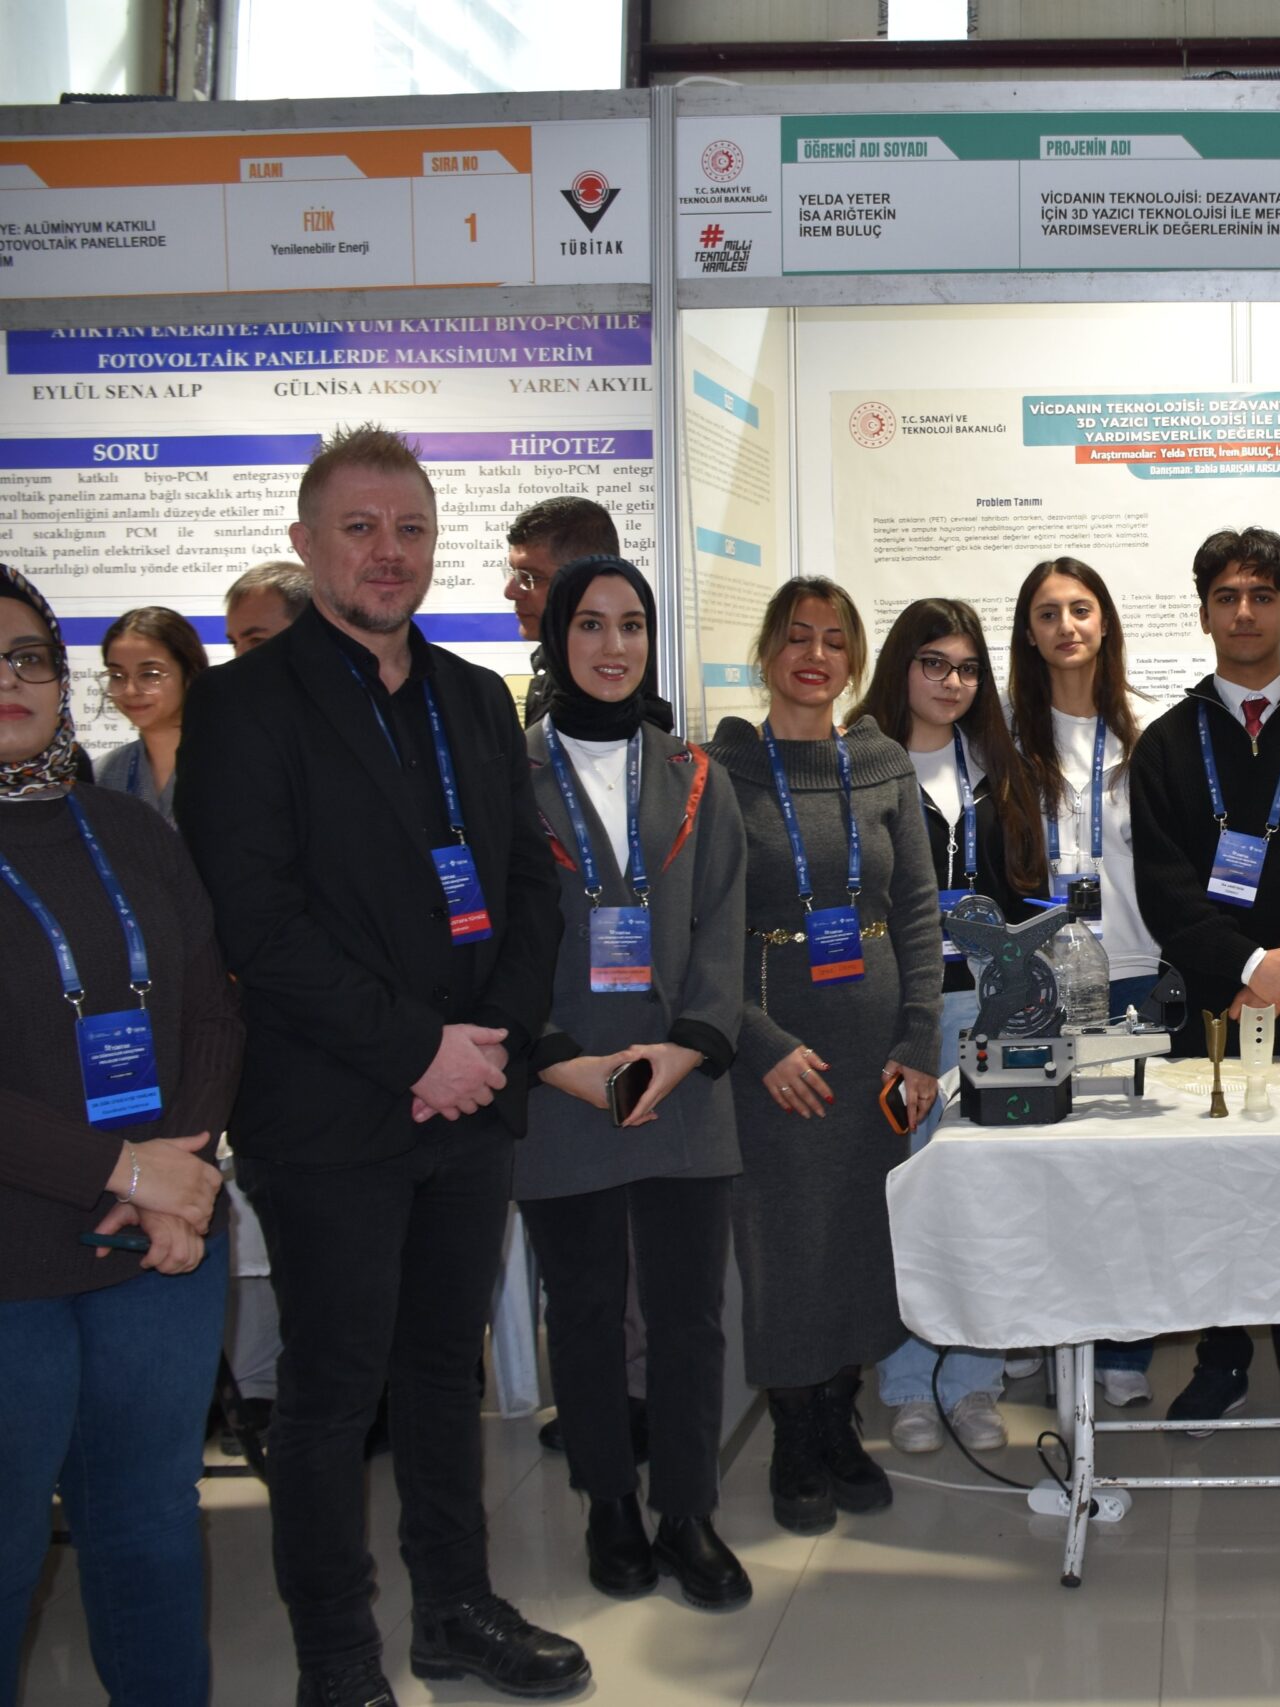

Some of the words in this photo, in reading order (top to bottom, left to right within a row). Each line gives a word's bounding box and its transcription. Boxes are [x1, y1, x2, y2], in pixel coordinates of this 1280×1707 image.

[804, 137, 855, 158] ÖĞRENCİ
[859, 136, 880, 157] ADI
[883, 136, 927, 157] SOYADI
[1046, 138, 1106, 155] PROJENİN
[1110, 140, 1131, 155] ADI
[249, 163, 282, 178] ALANI
[431, 157, 458, 172] SIRA
[462, 156, 478, 170] NO
[799, 194, 843, 205] YELDA
[846, 193, 890, 204] YETER
[1041, 190, 1105, 204] VİCDANIN
[1109, 189, 1201, 204] TEKNOLOJİSİ:
[303, 207, 334, 231] FİZİK
[799, 208, 821, 221] İSA
[823, 207, 896, 220] ARIĞTEKİN
[1041, 206, 1067, 222] İÇİN
[1071, 209, 1088, 220] 3D
[1092, 208, 1134, 219] YAZICI
[1138, 205, 1226, 220] TEKNOLOJİSİ
[1230, 206, 1250, 220] İLE
[24, 221, 102, 234] ALÜMİNYUM
[106, 221, 155, 232] KATKILI
[465, 214, 476, 242] 1
[799, 224, 831, 237] İREM
[836, 225, 881, 238] BULUÇ
[1041, 222, 1158, 235] YARDIMSEVERLİK
[1163, 222, 1262, 235] DEĞERLERİNİN
[271, 243, 336, 255] Yenilenebilir
[338, 242, 369, 255] Enerji
[560, 239, 622, 255] TÜBİTAK
[98, 350, 249, 368] FOTOVOLTAİK
[255, 349, 388, 366] PANELLERDE
[395, 346, 517, 363] MAKSİMUM
[523, 344, 592, 361] VERİM
[33, 382, 99, 400] EYLÜL
[105, 385, 157, 399] SENA
[164, 384, 202, 398] ALP
[273, 378, 361, 396] GÜLNİSA
[369, 380, 441, 394] AKSOY
[509, 379, 579, 393] YAREN
[1029, 402, 1101, 414] VİCDANIN
[1106, 399, 1204, 413] TEKNOLOJİSİ:
[901, 416, 917, 424] T.C.
[919, 415, 953, 423] SANAYİ
[1077, 418, 1096, 428] 3D
[1100, 417, 1148, 427] YAZICI
[1152, 413, 1246, 427] TEKNOLOJİSİ
[1251, 412, 1272, 425] İLE
[901, 426, 953, 434] TEKNOLOJİ
[955, 424, 1006, 433] BAKANLIĞI
[1085, 428, 1212, 442] YARDIMSEVERLİK
[510, 434, 615, 455] HİPOTEZ
[93, 444, 158, 461] SORU
[1090, 450, 1156, 460] Araştırmacılar:
[1160, 448, 1185, 458] Yelda
[1187, 447, 1216, 457] YETER,
[1218, 447, 1241, 456] İrem
[1241, 447, 1273, 458] BULUÇ,
[77, 472, 118, 483] katkılı
[144, 471, 208, 484] biyo-PCM
[976, 498, 1011, 507] Problem
[1014, 498, 1042, 506] Tanımı
